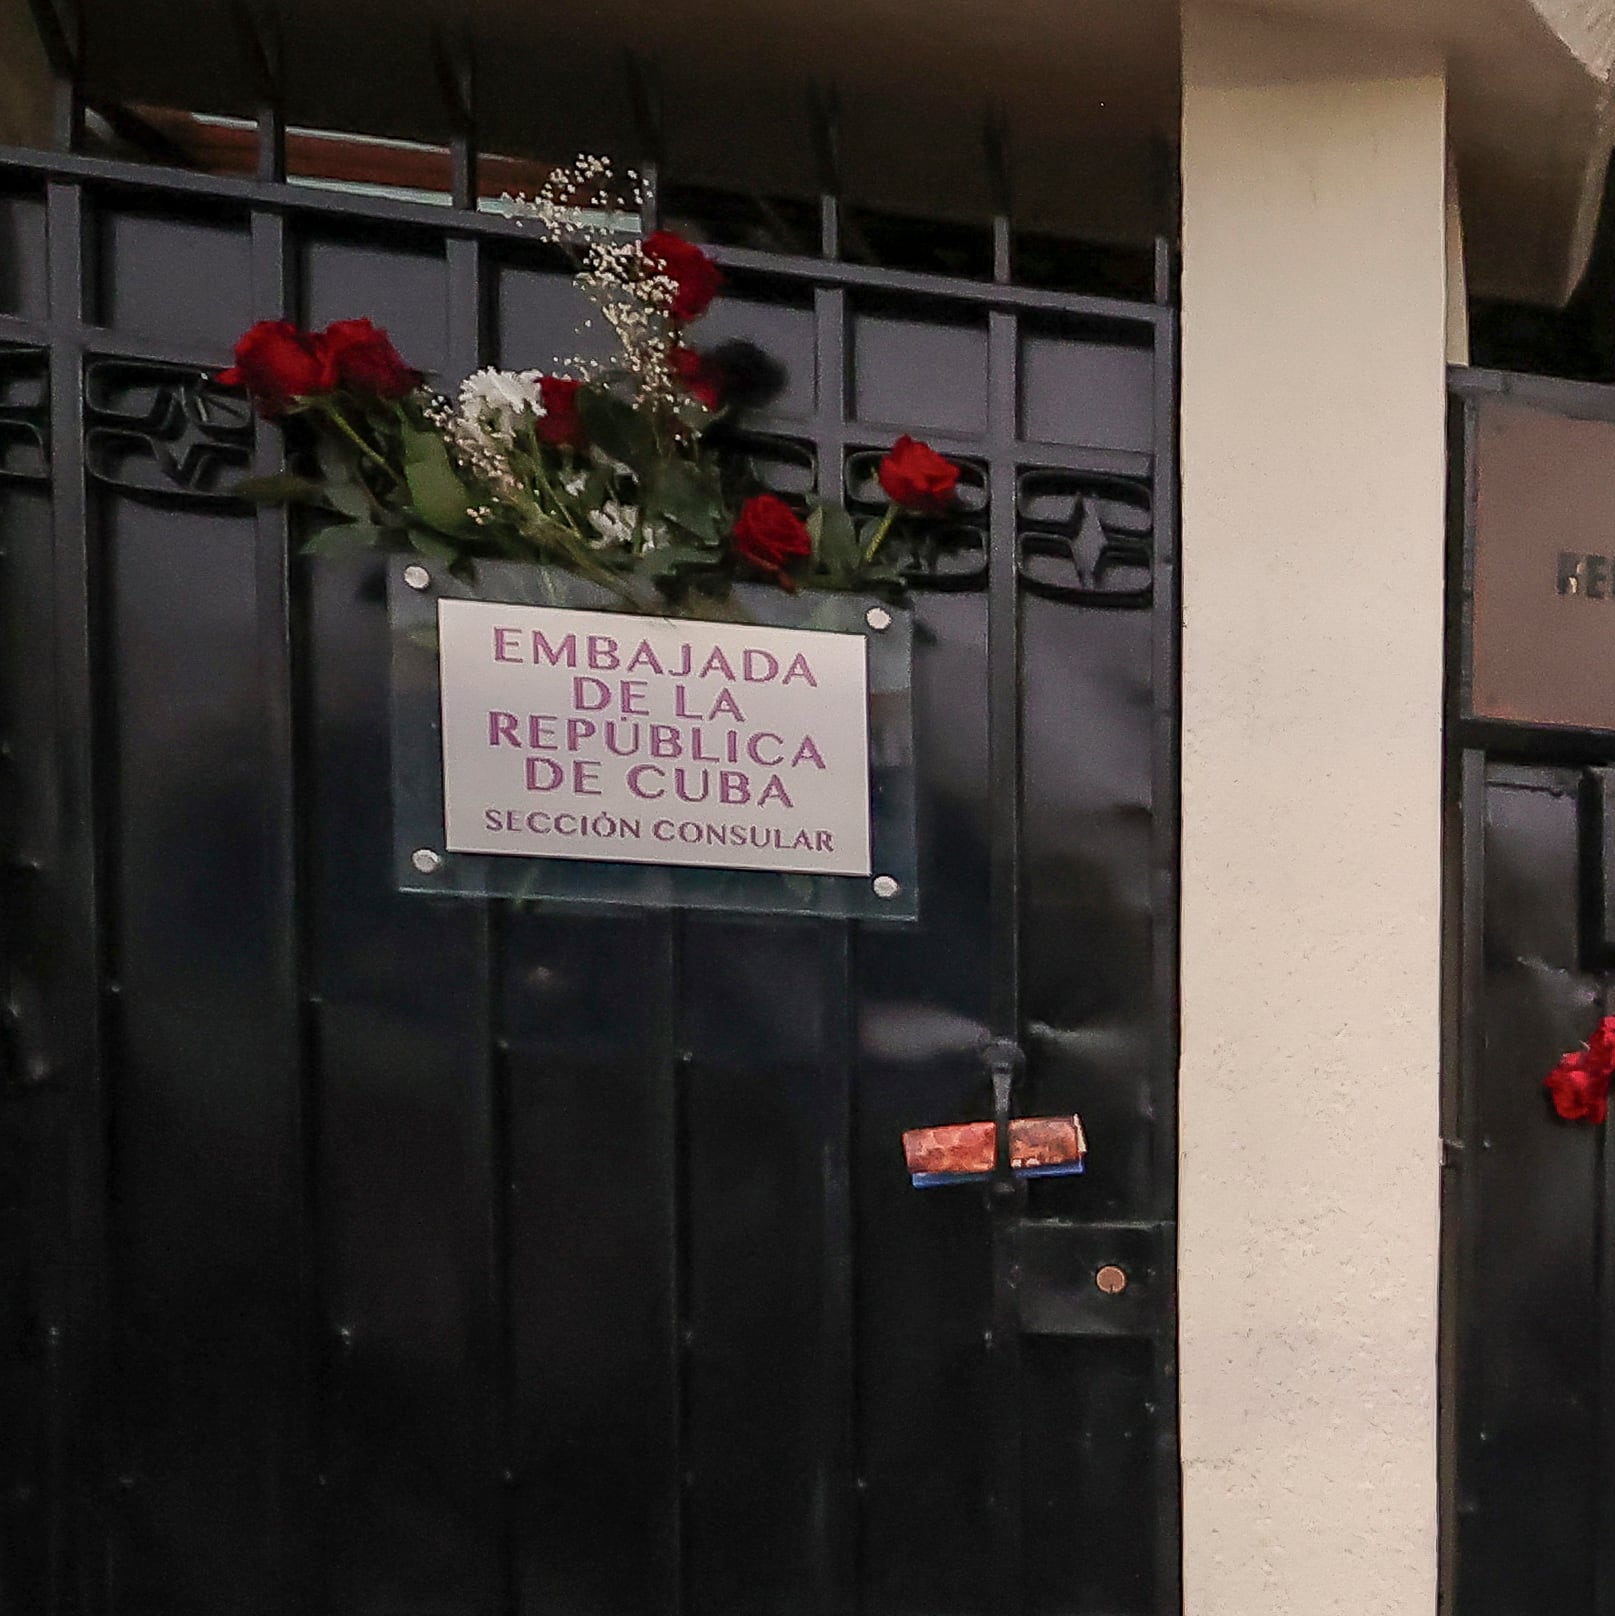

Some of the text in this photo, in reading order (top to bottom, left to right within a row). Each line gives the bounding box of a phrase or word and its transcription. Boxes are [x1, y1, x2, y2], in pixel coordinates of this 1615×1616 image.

[492, 625, 818, 689] EMBAJADA
[572, 675, 746, 723] DE LA
[487, 710, 827, 770] REPÚBLICA
[524, 756, 794, 809] DE CUBA
[484, 807, 835, 854] SECCIÓN CONSULAR
